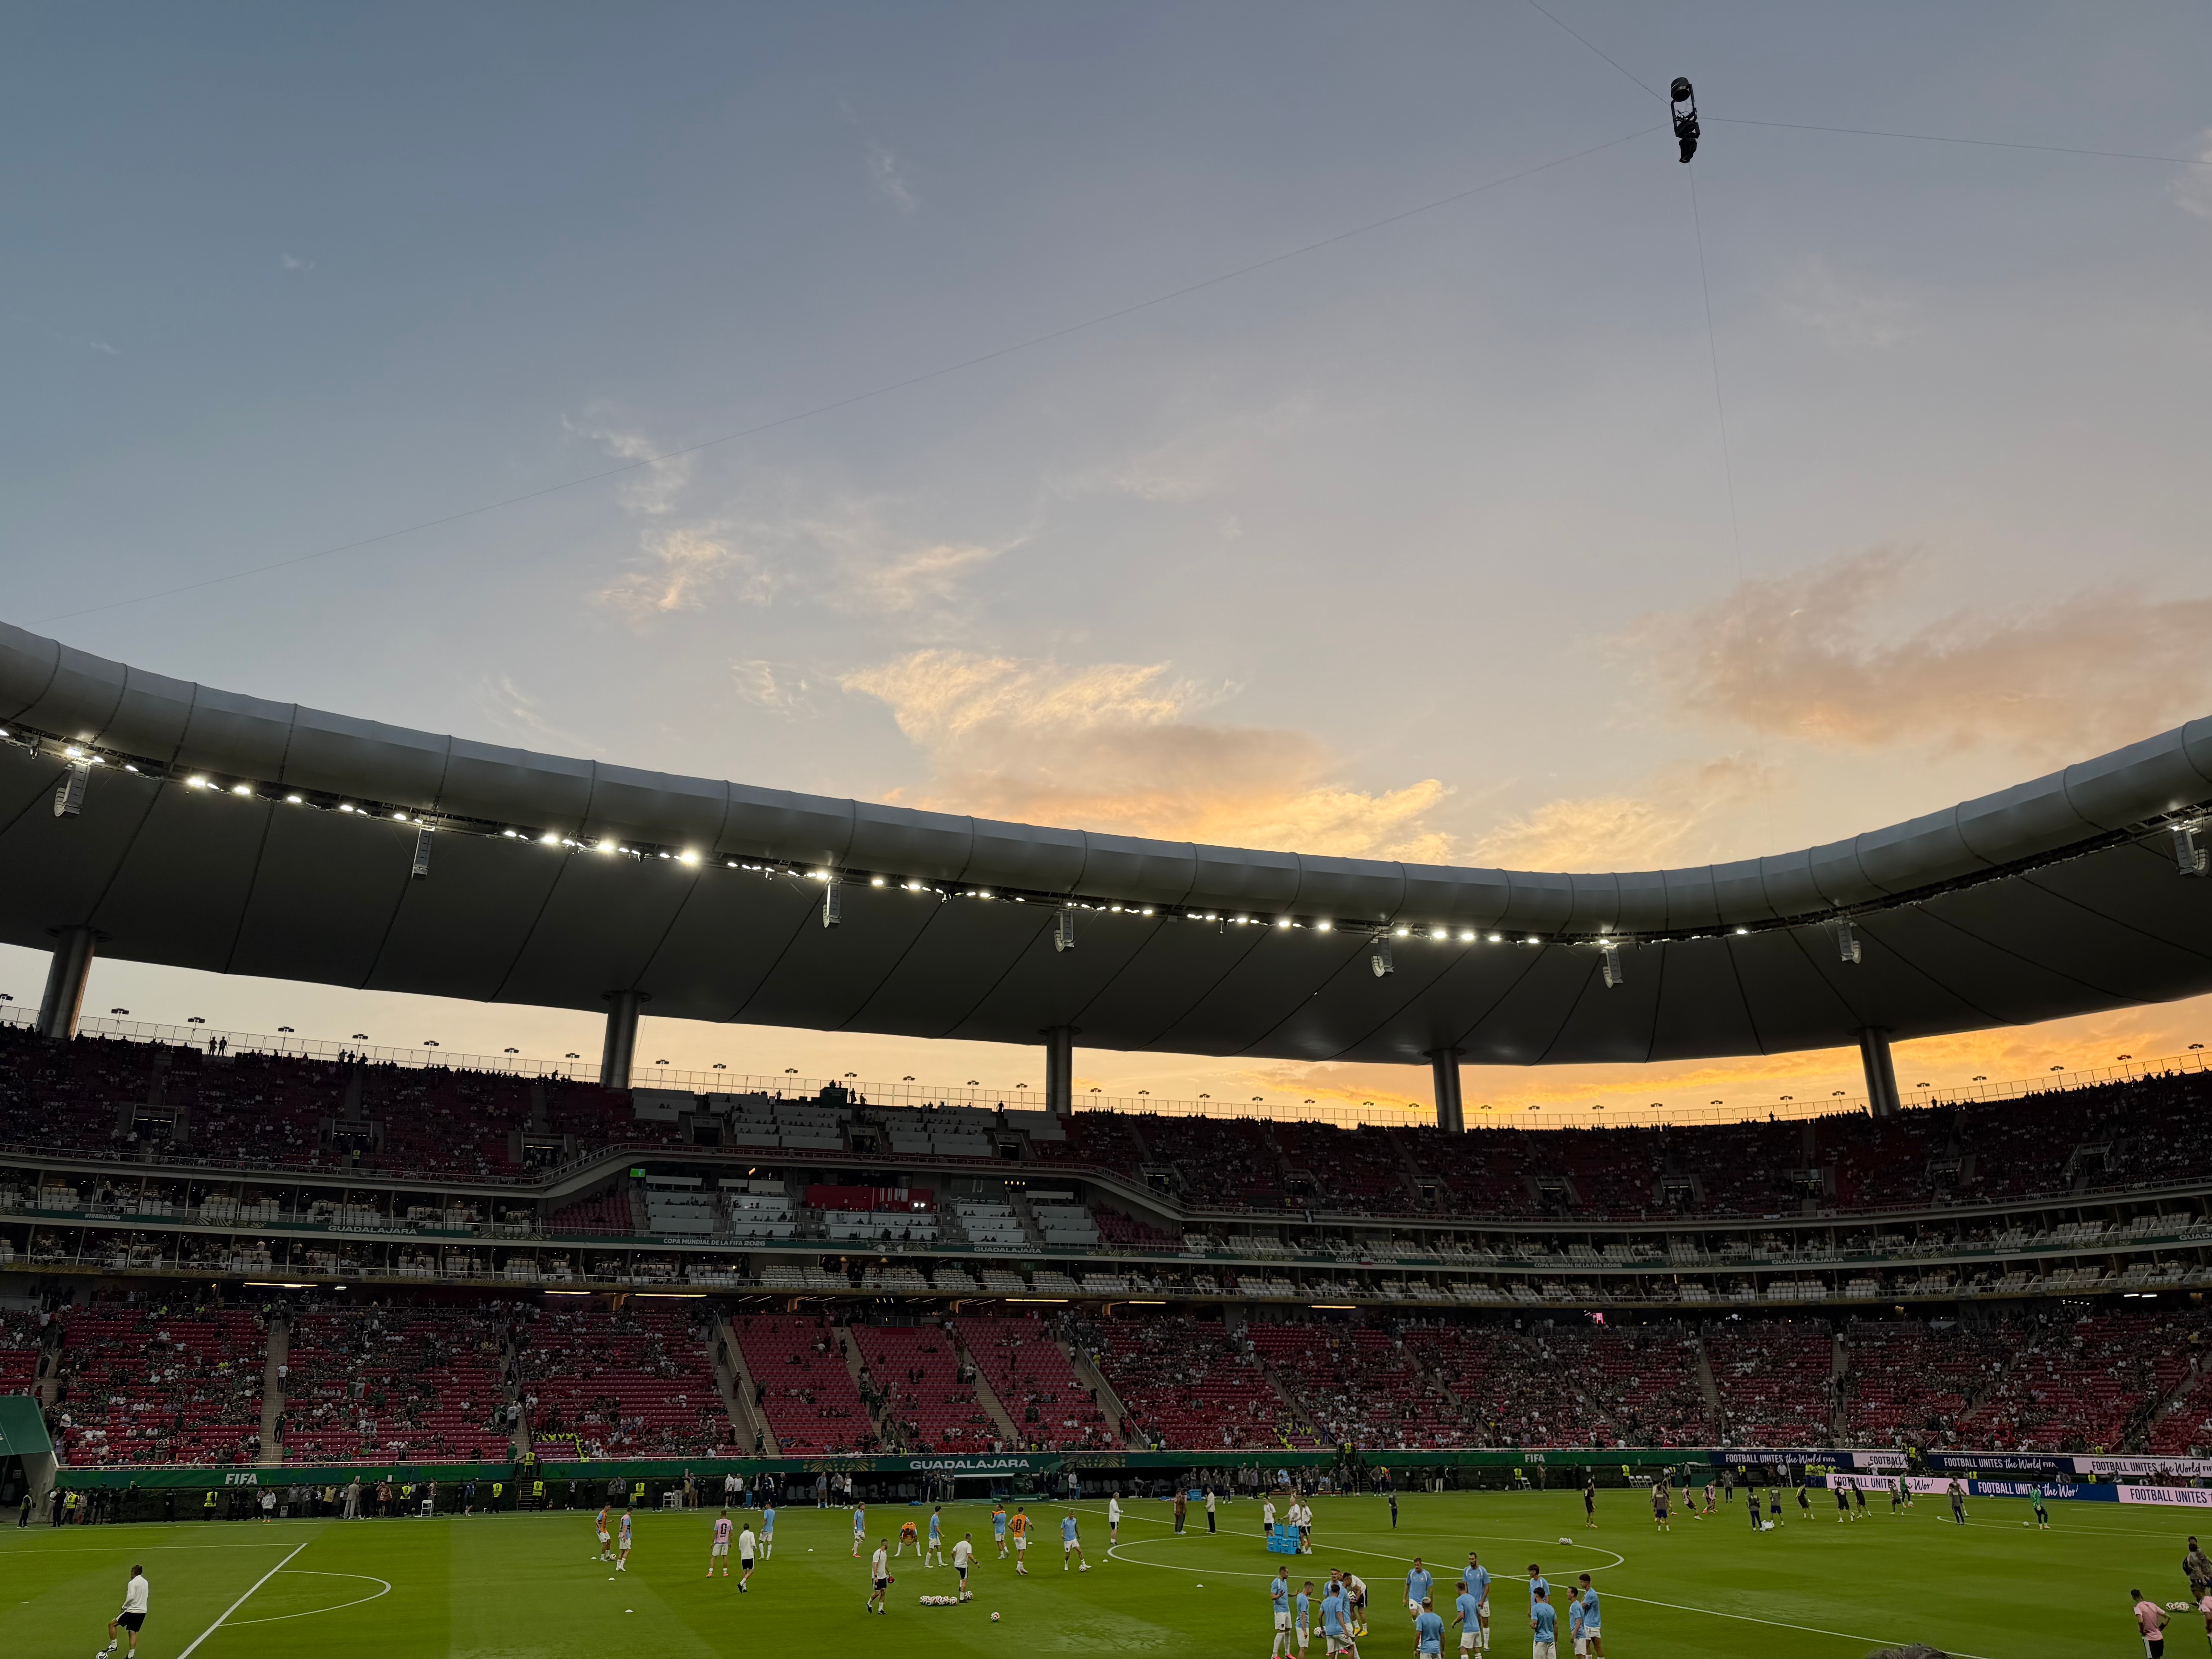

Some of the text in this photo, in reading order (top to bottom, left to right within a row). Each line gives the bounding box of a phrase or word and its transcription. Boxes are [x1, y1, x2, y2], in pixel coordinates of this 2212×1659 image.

[328, 1225, 417, 1235] GUADALAJARA
[1525, 1454, 1546, 1463] FIFA
[1726, 1454, 1759, 1463] FOOTBALL
[1760, 1455, 1783, 1464] UNITES
[1784, 1454, 1798, 1464] the
[1798, 1453, 1822, 1464] World
[1944, 1458, 1977, 1467] FOOTBALL
[1978, 1458, 2002, 1468] UNITES
[2003, 1458, 2018, 1469] the
[2018, 1458, 2041, 1470] World
[910, 1459, 1030, 1470] GUADALAJARA
[2092, 1462, 2129, 1472] FOOTBALL
[2130, 1462, 2157, 1472] UNITES
[2159, 1461, 2174, 1472] the
[2174, 1462, 2201, 1475] World
[225, 1473, 258, 1484] FIFA
[1978, 1482, 2014, 1494] FOOTBALL
[2042, 1483, 2058, 1497] the
[2130, 1488, 2173, 1502] FOOTBALL
[2175, 1490, 2207, 1503] UNITES
